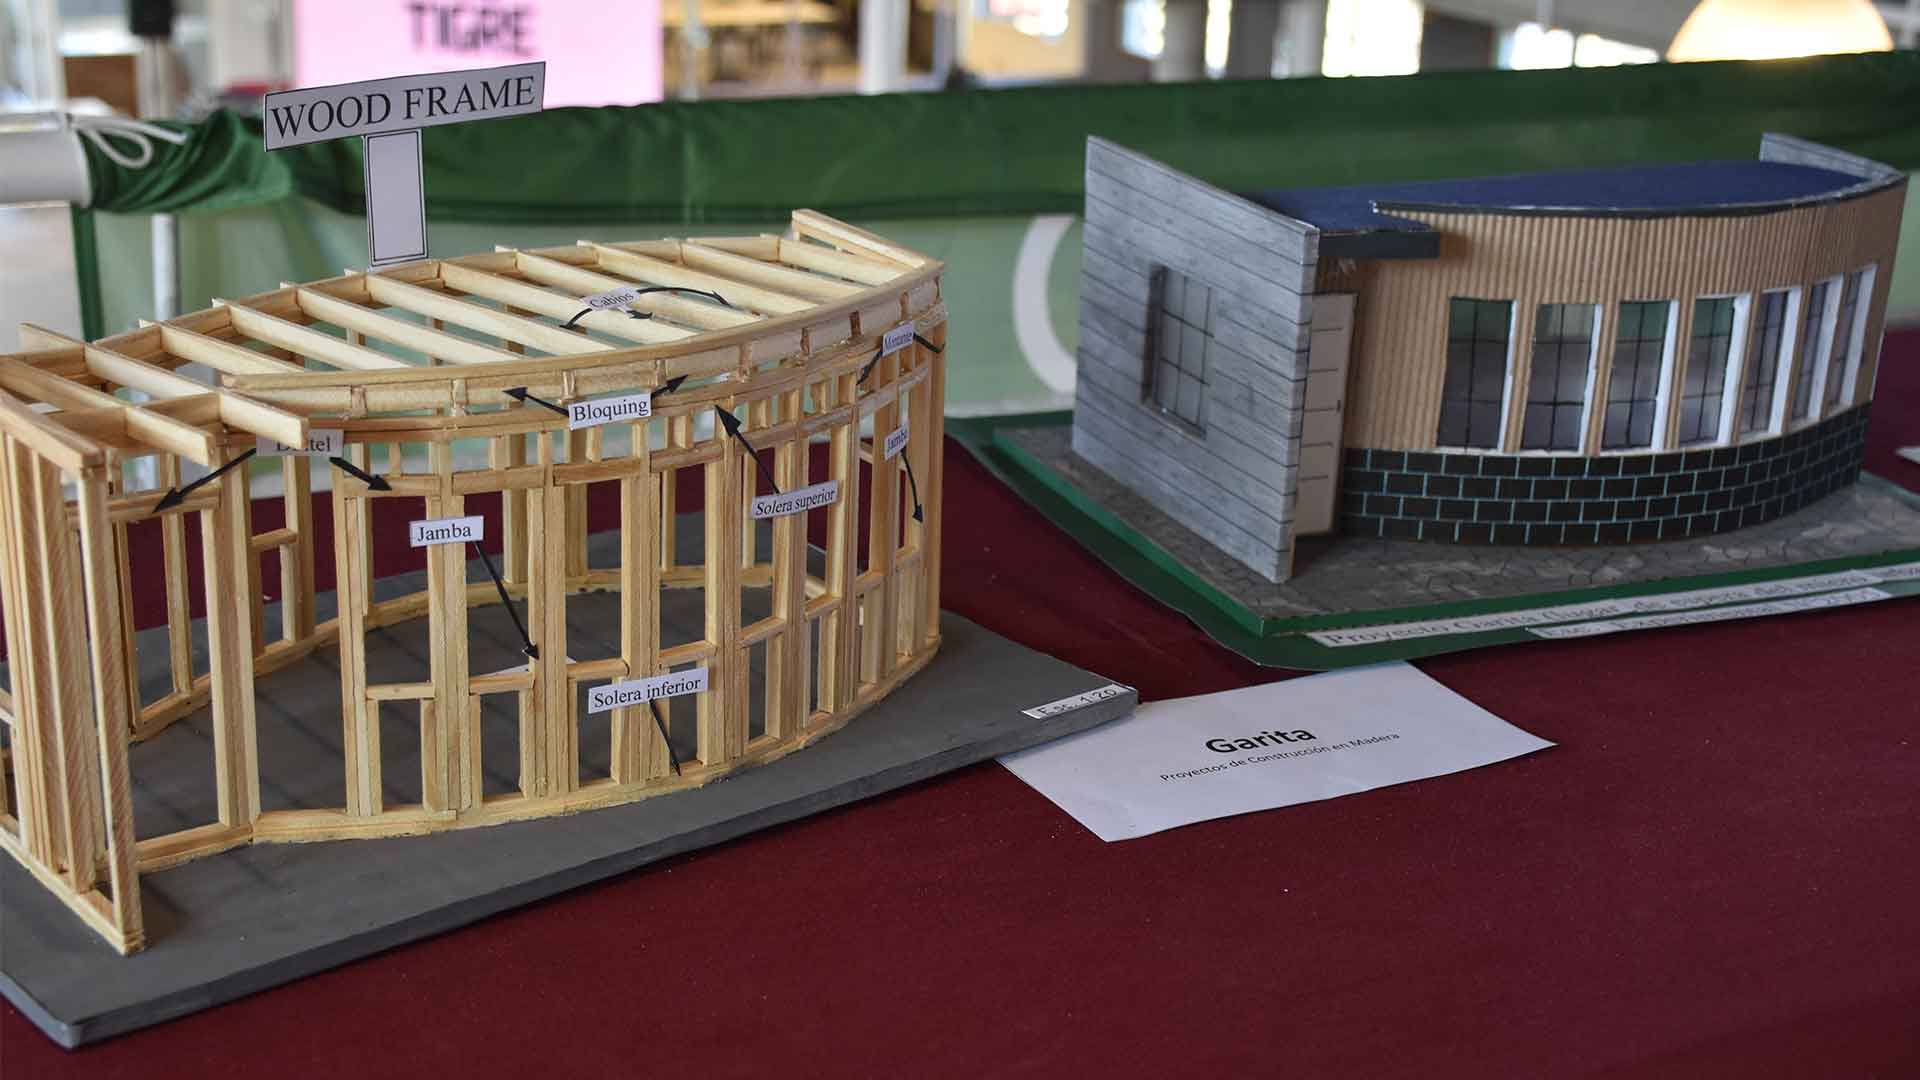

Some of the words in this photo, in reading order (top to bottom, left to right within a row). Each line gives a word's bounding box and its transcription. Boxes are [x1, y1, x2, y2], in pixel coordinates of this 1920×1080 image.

[407, 2, 533, 55] TIGRE
[271, 93, 391, 139] WOOD
[403, 75, 536, 120] FRAME
[573, 399, 649, 422] Bloquing
[755, 499, 793, 516] Solera
[794, 488, 835, 511] superior
[417, 523, 472, 542] Jamba
[594, 689, 641, 708] Solera
[647, 678, 701, 699] inferior
[1205, 728, 1317, 753] Garita
[1159, 762, 1228, 782] Proyectos
[1229, 759, 1248, 769] de
[1247, 745, 1331, 765] Construcción
[1331, 743, 1351, 752] en
[1350, 733, 1401, 748] Madera
